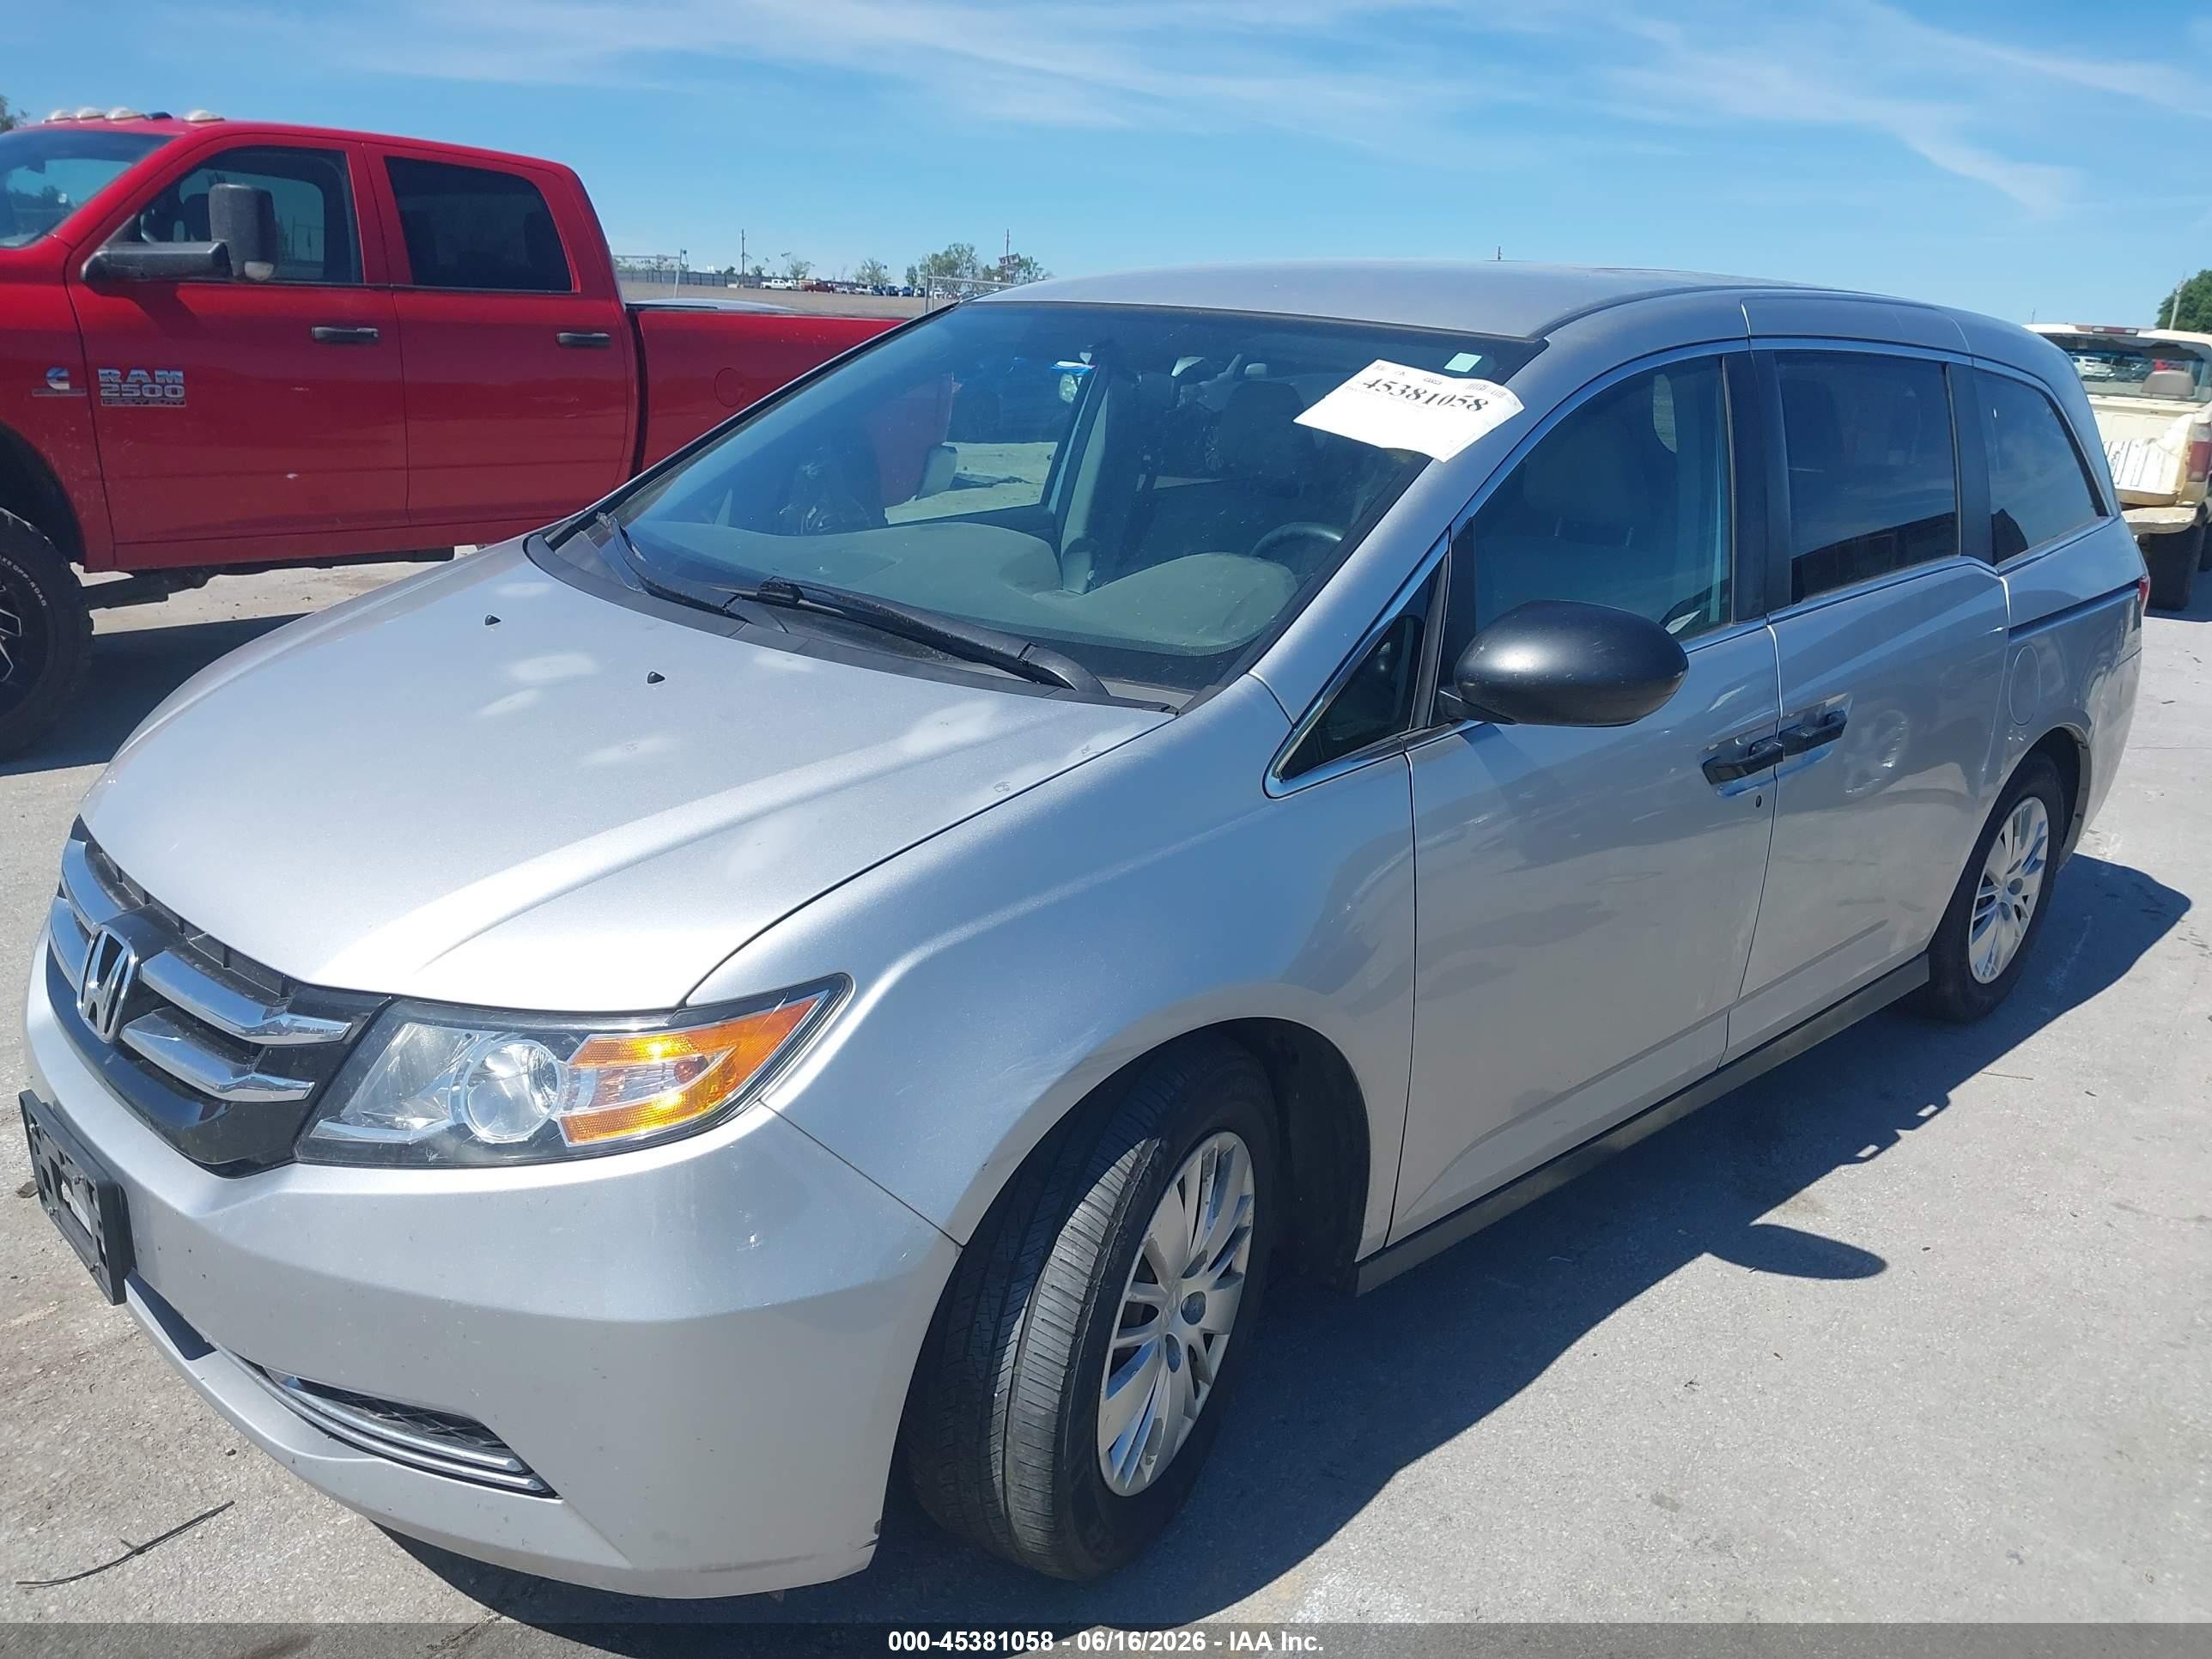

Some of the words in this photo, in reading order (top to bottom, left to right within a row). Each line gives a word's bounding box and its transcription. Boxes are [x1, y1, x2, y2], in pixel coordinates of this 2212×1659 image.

[97, 368, 184, 384] RAM
[100, 383, 185, 398] 2500
[1362, 378, 1489, 412] 45381058
